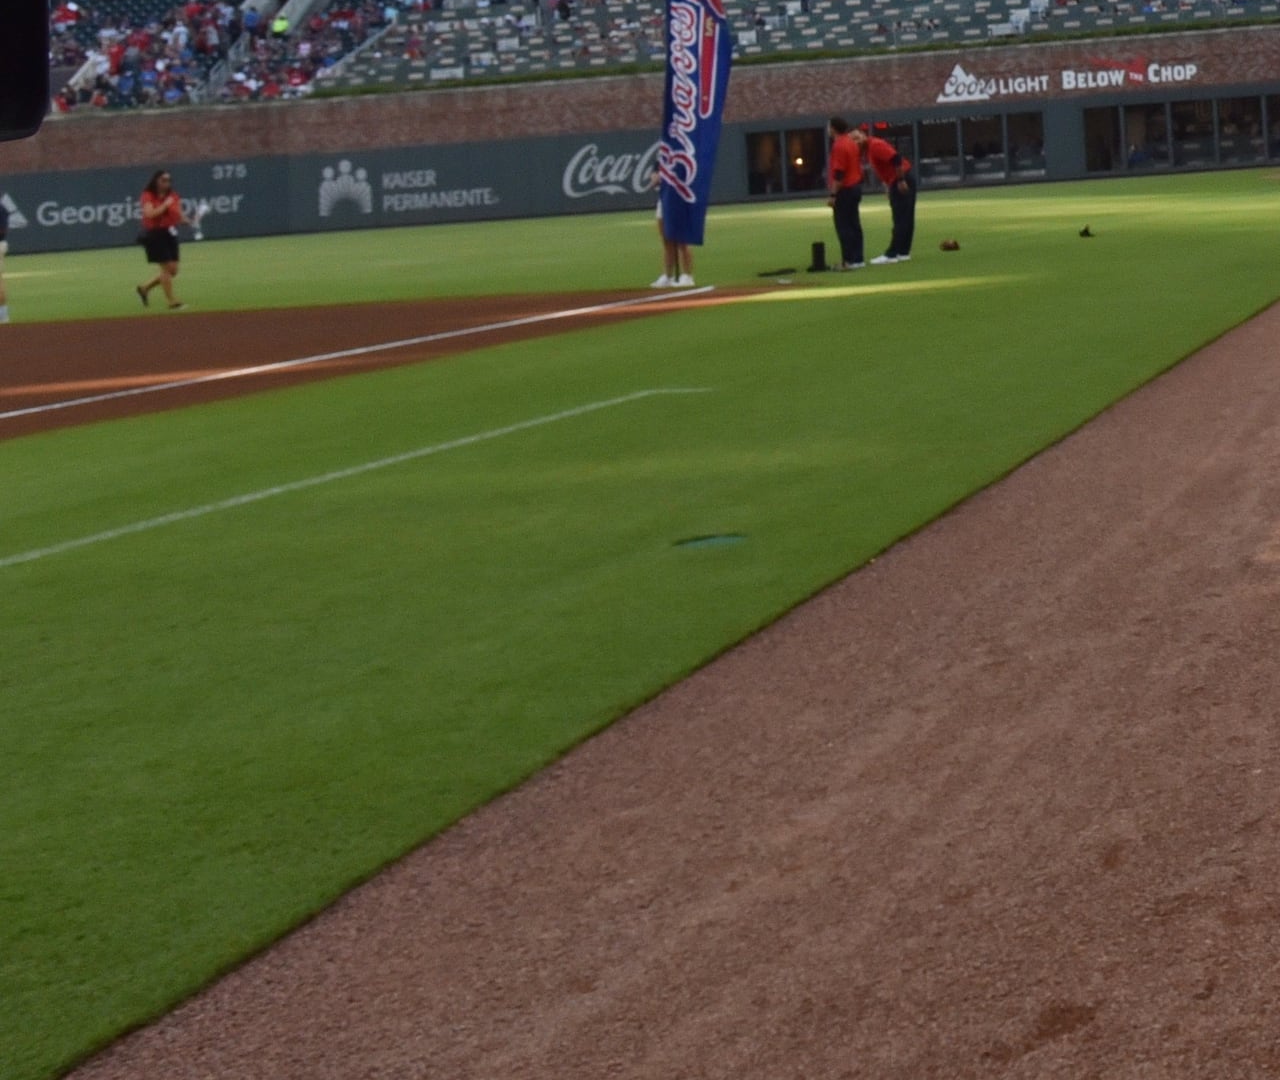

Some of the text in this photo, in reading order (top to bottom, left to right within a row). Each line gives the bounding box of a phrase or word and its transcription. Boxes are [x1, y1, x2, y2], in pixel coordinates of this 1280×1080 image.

[943, 75, 1050, 98] Coors LIGHT
[1062, 70, 1126, 90] BELOW
[1148, 63, 1198, 84] CHOP
[660, 1, 697, 204] Braves
[382, 170, 437, 189] KAISER
[563, 143, 662, 199] Coca-C
[36, 193, 244, 227] Georgia ower
[383, 187, 497, 212] PERMANENTE
